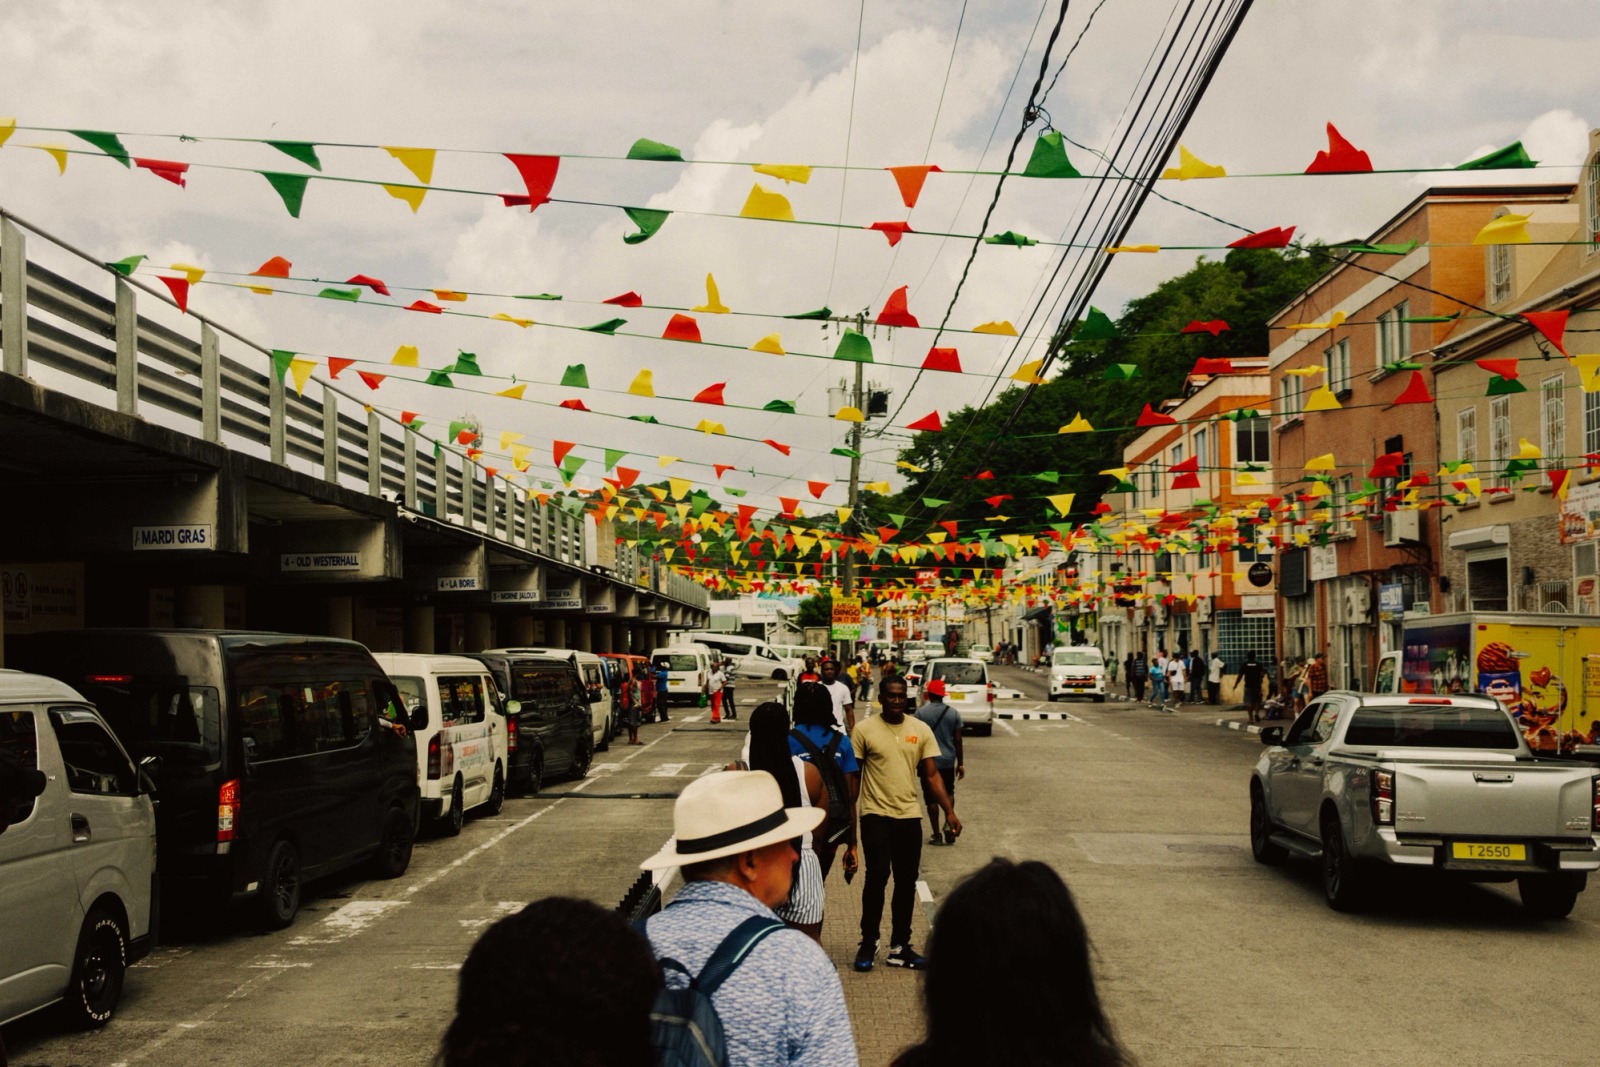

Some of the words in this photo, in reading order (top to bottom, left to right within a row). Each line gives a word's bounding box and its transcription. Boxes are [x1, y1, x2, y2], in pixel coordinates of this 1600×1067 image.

[141, 529, 175, 545] MARDI
[178, 528, 206, 544] GRAS
[296, 556, 312, 567] OLD
[313, 555, 359, 567] WESTERHALL
[918, 571, 938, 579] KFC
[449, 579, 458, 588] LA
[459, 579, 475, 588] BORIE
[500, 591, 517, 600] MORNE
[518, 590, 537, 600] JALOUX
[833, 608, 861, 616] BINGO
[1467, 845, 1475, 857] T
[1478, 845, 1511, 858] 2550
